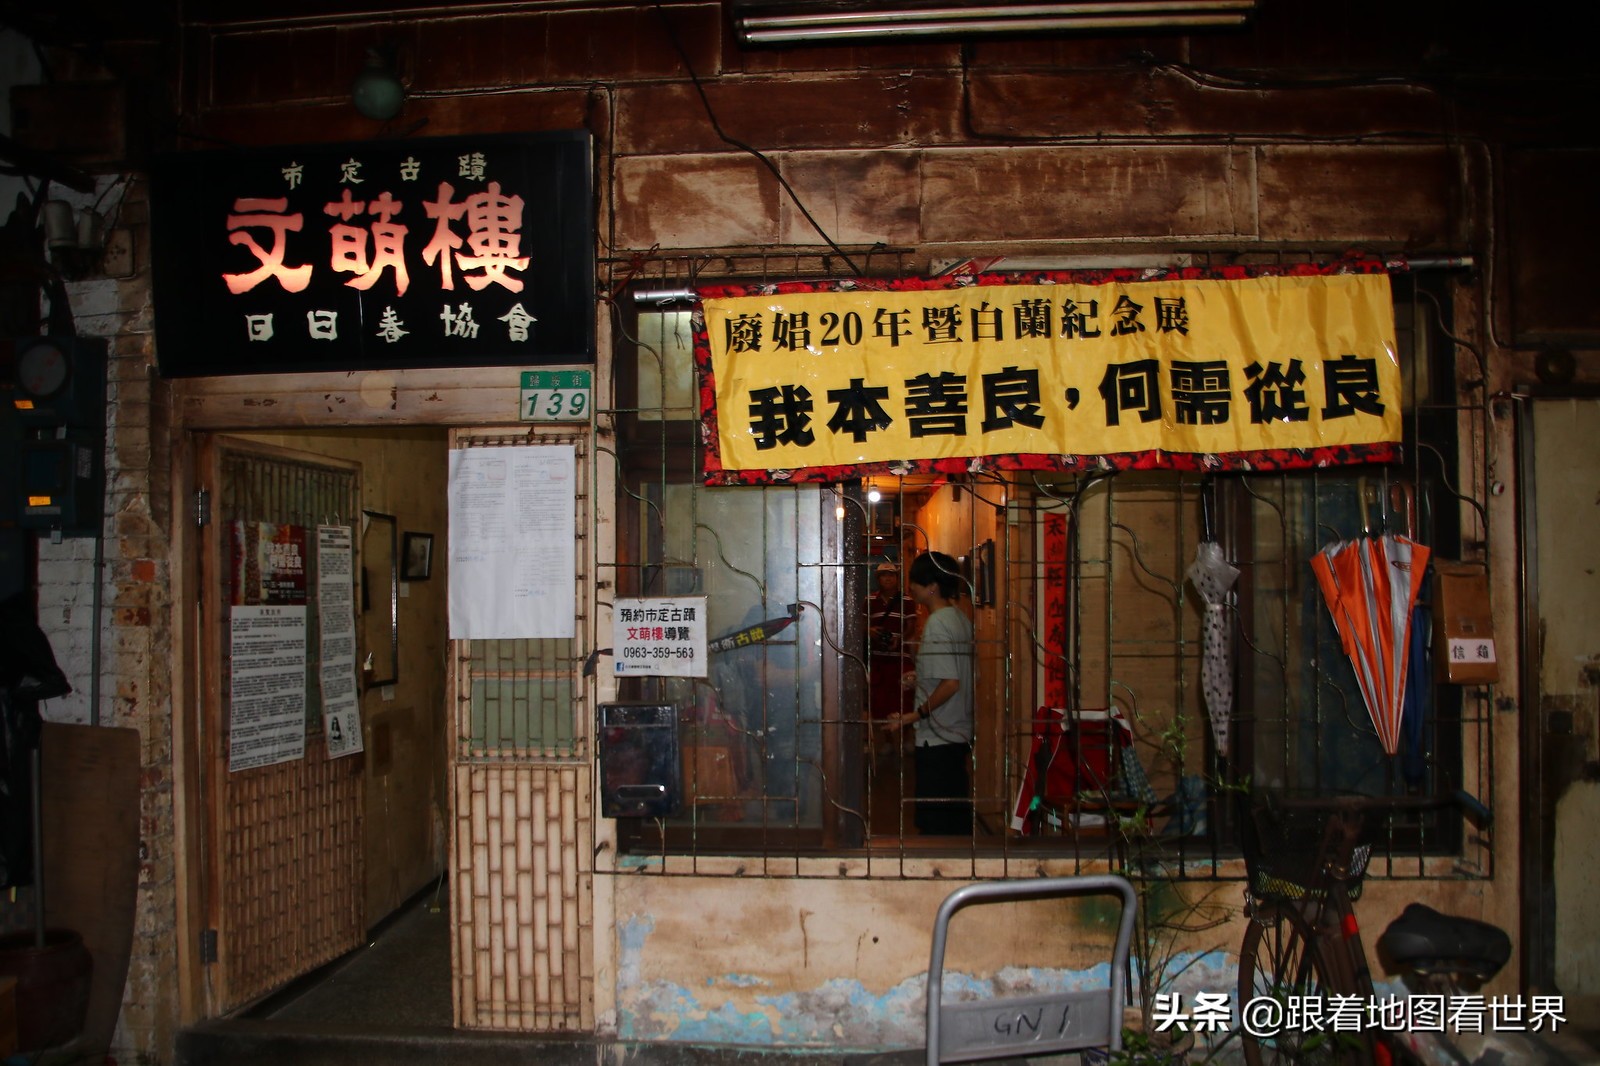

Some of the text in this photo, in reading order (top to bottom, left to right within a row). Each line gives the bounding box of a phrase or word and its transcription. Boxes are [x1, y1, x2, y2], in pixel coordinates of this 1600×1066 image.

[282, 152, 487, 190] 市定古蹟
[222, 181, 531, 297] 文萌樓
[246, 303, 538, 342] 日日春協會
[724, 295, 1190, 355] 廢娼20年暨白蘭紀念展
[527, 392, 586, 416] 139
[620, 608, 696, 623] 預約市定古蹟
[627, 626, 690, 641] 文萌樓導覽
[623, 647, 694, 659] 0963-359-563
